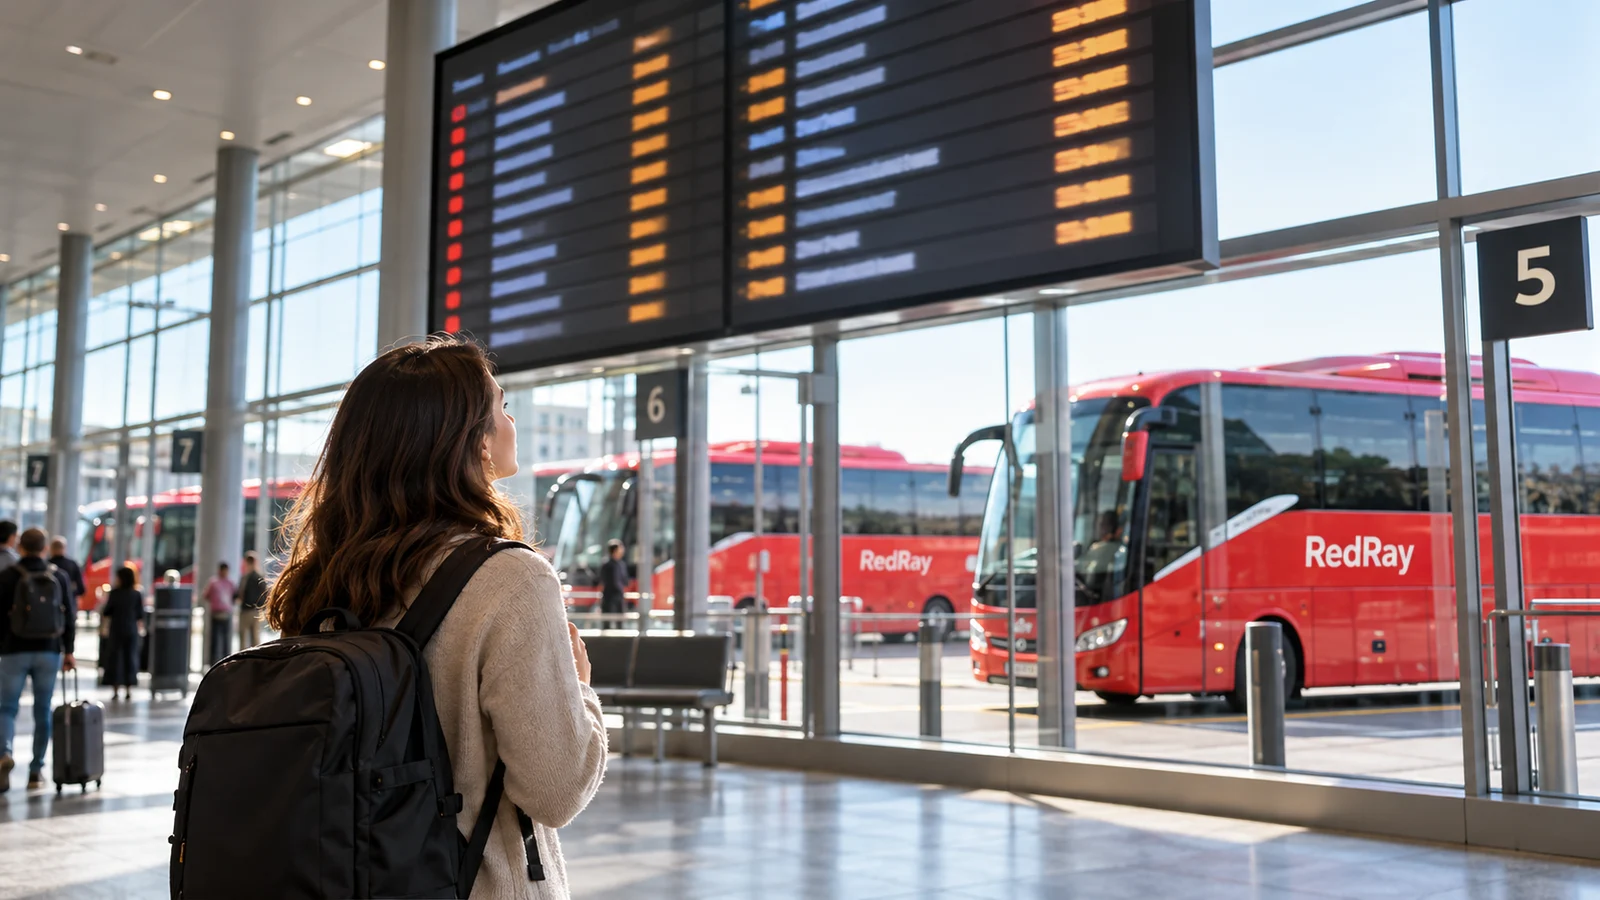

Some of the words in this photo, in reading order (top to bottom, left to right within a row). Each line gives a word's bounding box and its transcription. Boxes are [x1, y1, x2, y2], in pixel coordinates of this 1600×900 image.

[1515, 245, 1556, 306] 5
[647, 386, 666, 424] 6
[179, 437, 195, 466] 7
[31, 460, 44, 483] 7
[859, 549, 933, 577] RedRay
[1305, 535, 1415, 576] RedRay
